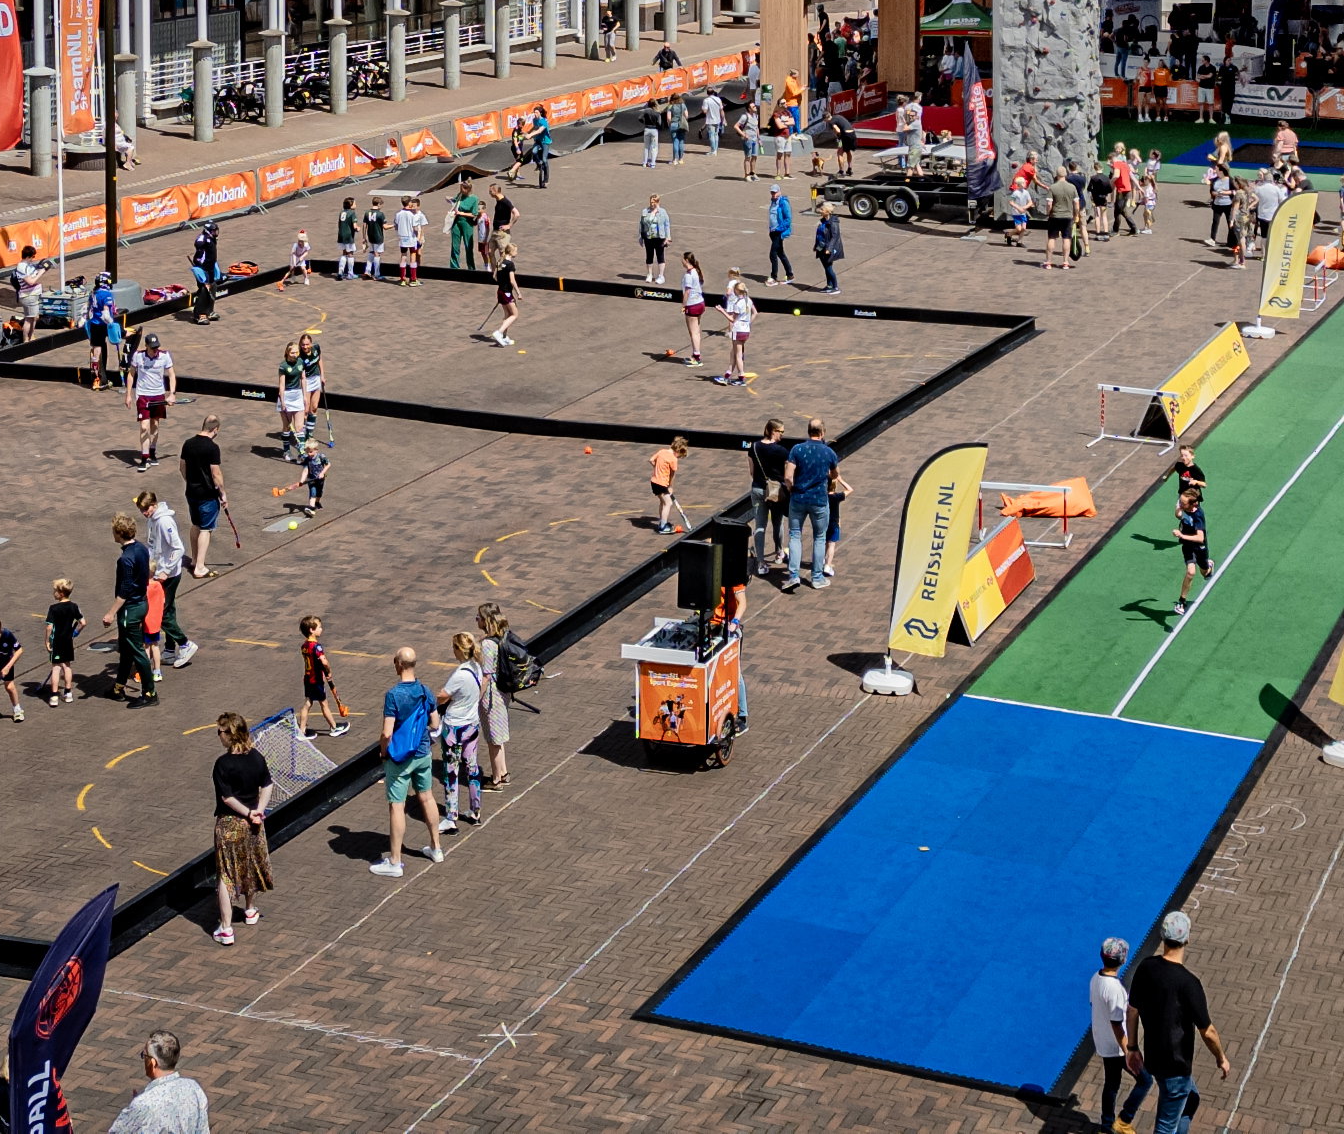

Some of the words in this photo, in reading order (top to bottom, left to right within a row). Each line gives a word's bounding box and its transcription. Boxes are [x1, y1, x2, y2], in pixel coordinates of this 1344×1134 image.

[67, 29, 84, 115] TeamNL
[309, 153, 345, 177] Rabobank
[197, 181, 248, 208] Rabobank
[1279, 213, 1299, 286] REISJEFIT.NL
